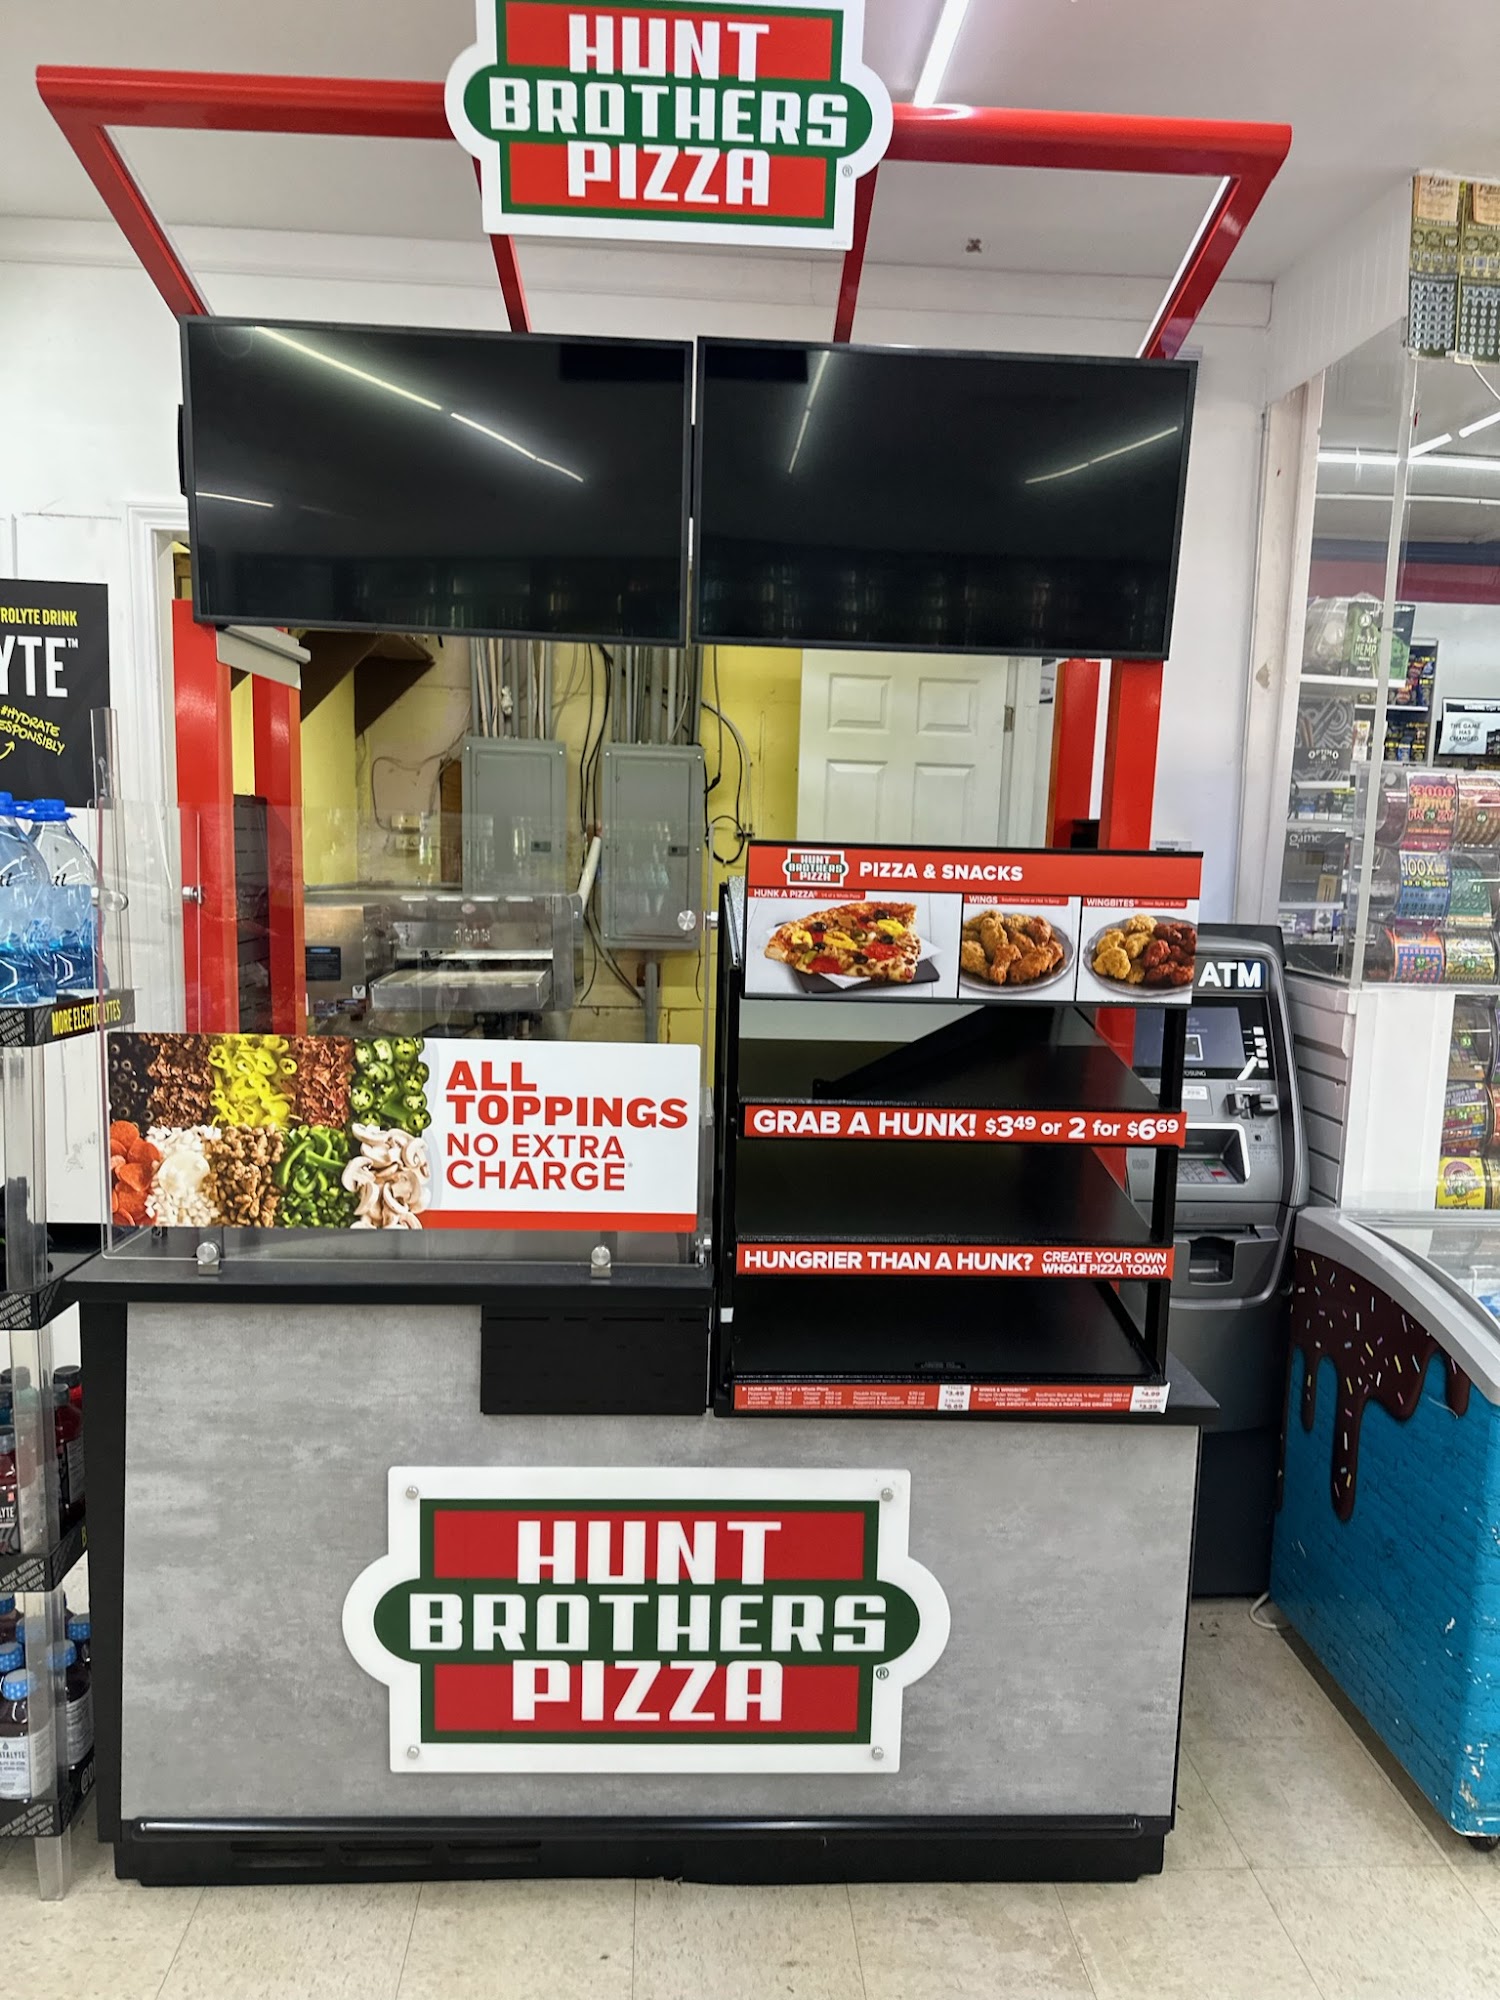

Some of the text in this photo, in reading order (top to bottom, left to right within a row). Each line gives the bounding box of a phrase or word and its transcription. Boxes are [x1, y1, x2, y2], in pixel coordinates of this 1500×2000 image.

[568, 14, 770, 82] HUNT
[489, 76, 848, 148] BROTHERS
[567, 141, 770, 207] PIZZA
[42, 609, 78, 627] DRINK
[0, 705, 61, 738] #HYDRATE
[789, 863, 843, 874] BROTHERS
[800, 855, 831, 864] HUNT
[860, 861, 1023, 882] PIZZA & SNACKS
[800, 872, 831, 881] PIZZA
[754, 889, 779, 898] HUNK
[781, 890, 788, 898] A
[969, 895, 998, 904] WINGS
[1198, 961, 1262, 988] ATM
[52, 1008, 73, 1036] MORE
[446, 1060, 537, 1092] ALL
[446, 1094, 688, 1129] TOPPINGS
[753, 1110, 840, 1135] GRAB
[848, 1111, 871, 1136] A
[879, 1112, 977, 1138] HUNK!
[1041, 1119, 1062, 1137] or
[1068, 1117, 1086, 1139] 2
[1093, 1119, 1121, 1138] for
[447, 1133, 625, 1159] NO EXTRA
[446, 1160, 625, 1191] CHARGE
[744, 1251, 1034, 1272] HUNGRIER THAN A HUNK?
[1041, 1263, 1167, 1275] WHOLE PIZZA TODAY
[1043, 1251, 1167, 1264] CREATE YOUR OWN
[516, 1521, 782, 1585] HUNT
[409, 1593, 887, 1652] BROTHERS
[512, 1660, 783, 1721] PIZZA
